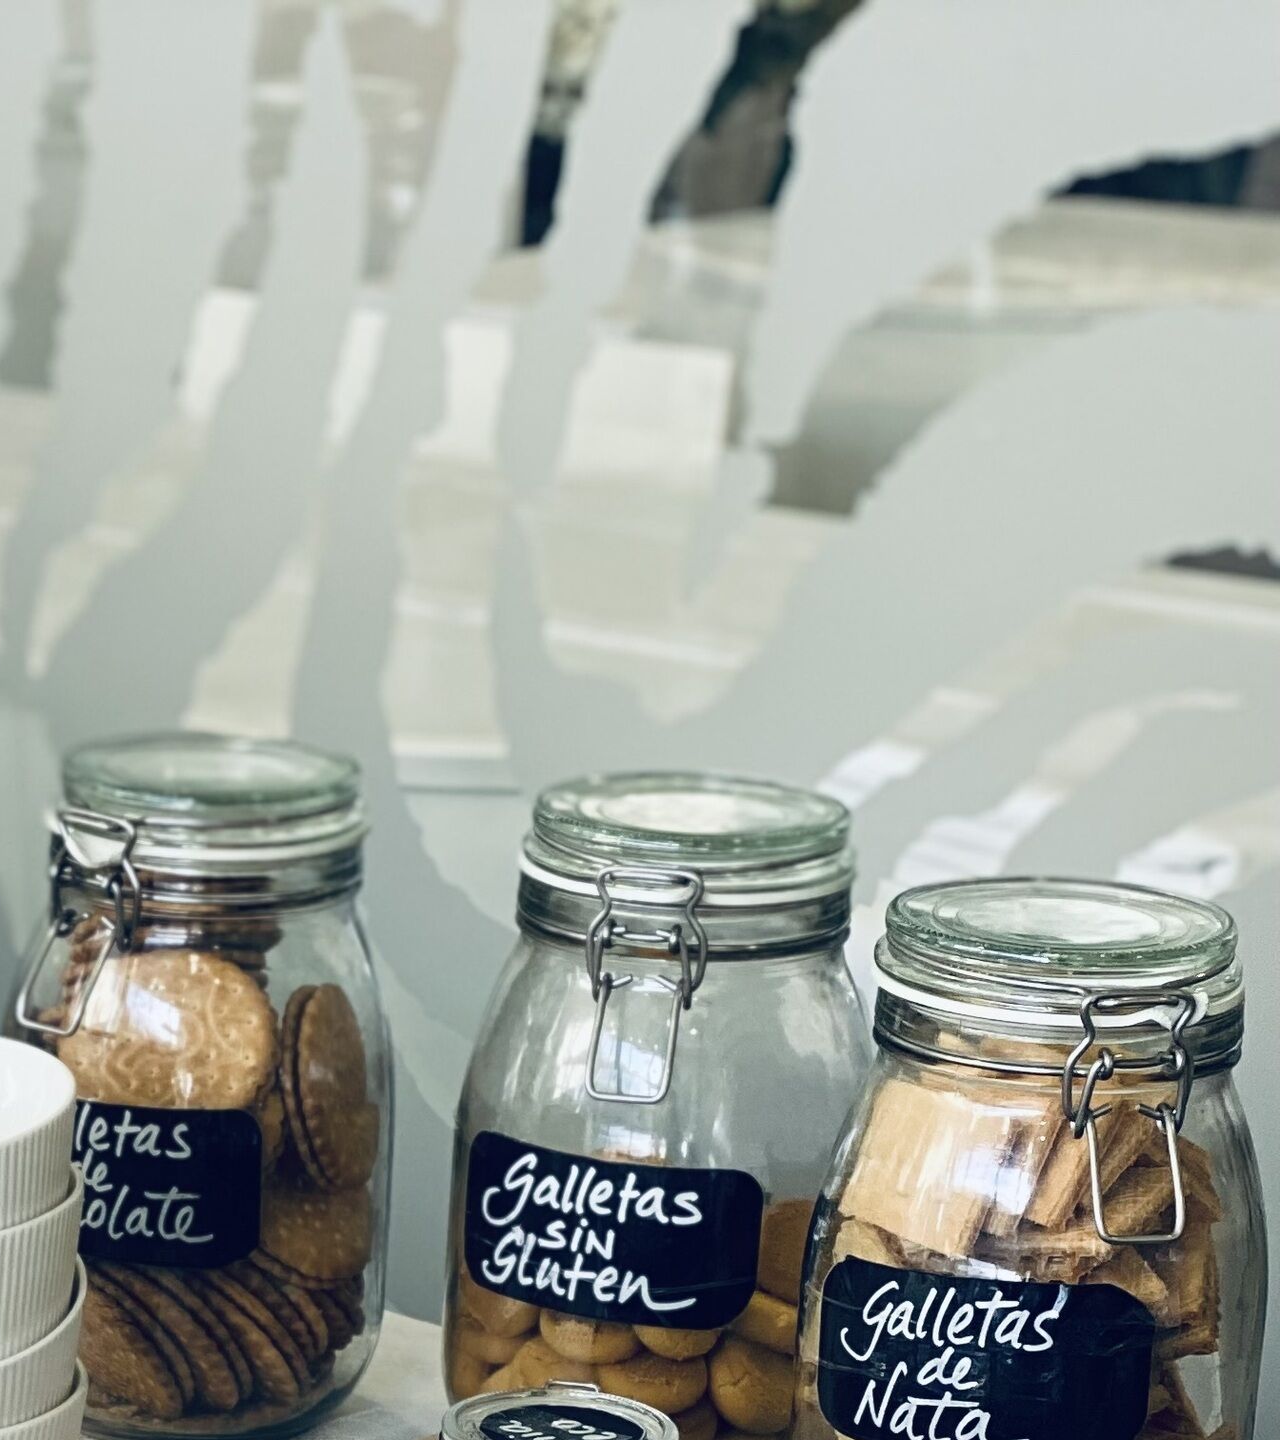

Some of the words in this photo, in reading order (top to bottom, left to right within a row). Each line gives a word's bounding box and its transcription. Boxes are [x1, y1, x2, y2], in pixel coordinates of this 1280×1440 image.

[482, 1153, 703, 1226] Galletas
[840, 1281, 1062, 1361] Galletas
[916, 1346, 980, 1391] de
